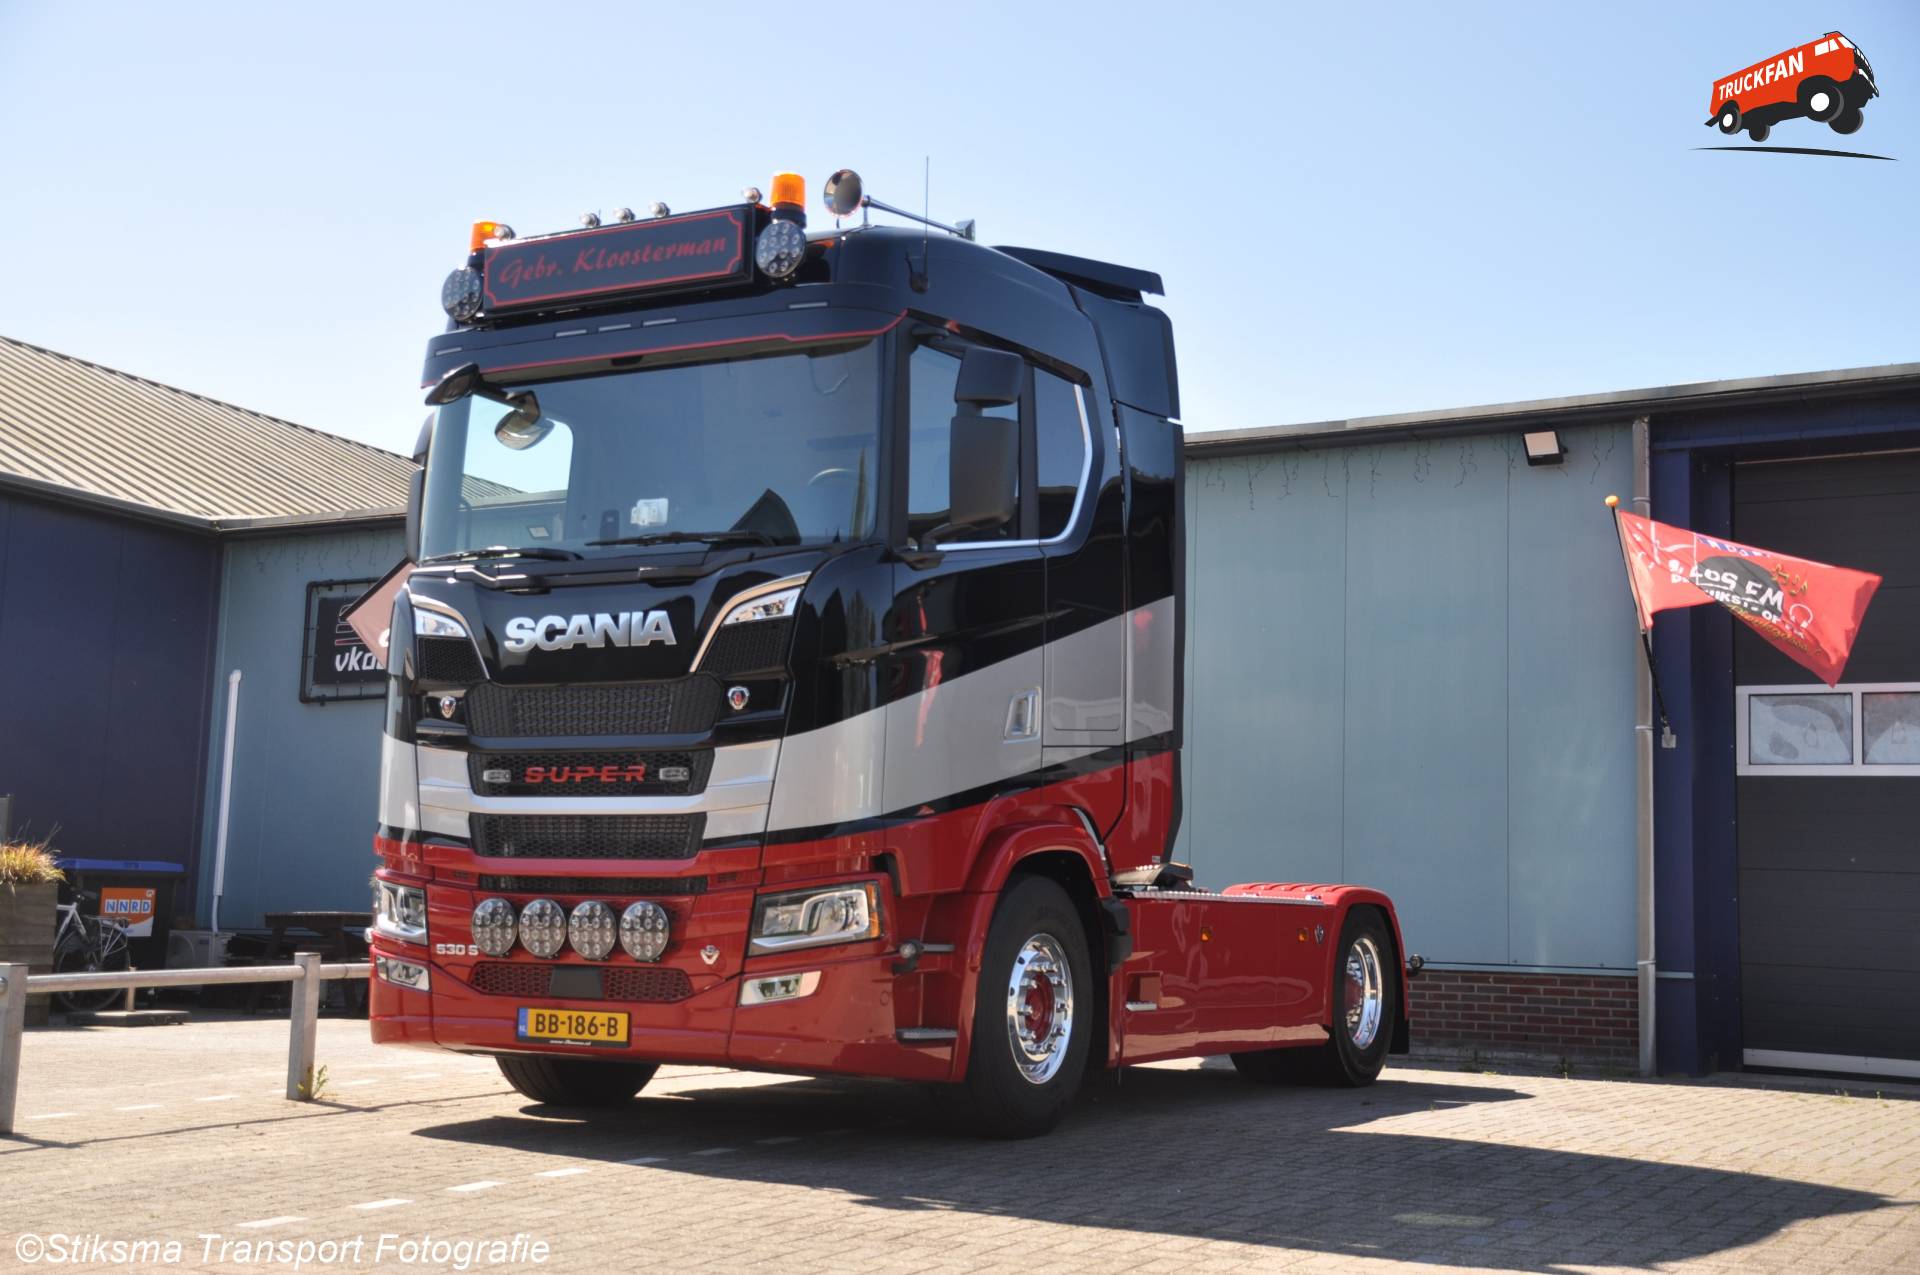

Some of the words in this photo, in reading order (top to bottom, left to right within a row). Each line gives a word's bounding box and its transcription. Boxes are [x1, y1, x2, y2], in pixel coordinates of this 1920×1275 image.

[500, 253, 563, 289] Gebr.
[573, 237, 728, 273] Kloosterman
[503, 610, 677, 653] SCANIA
[524, 765, 646, 783] SUPER
[105, 899, 151, 913] NNRD
[436, 943, 466, 956] 530
[468, 944, 479, 956] S
[535, 1013, 618, 1037] BB-186-B
